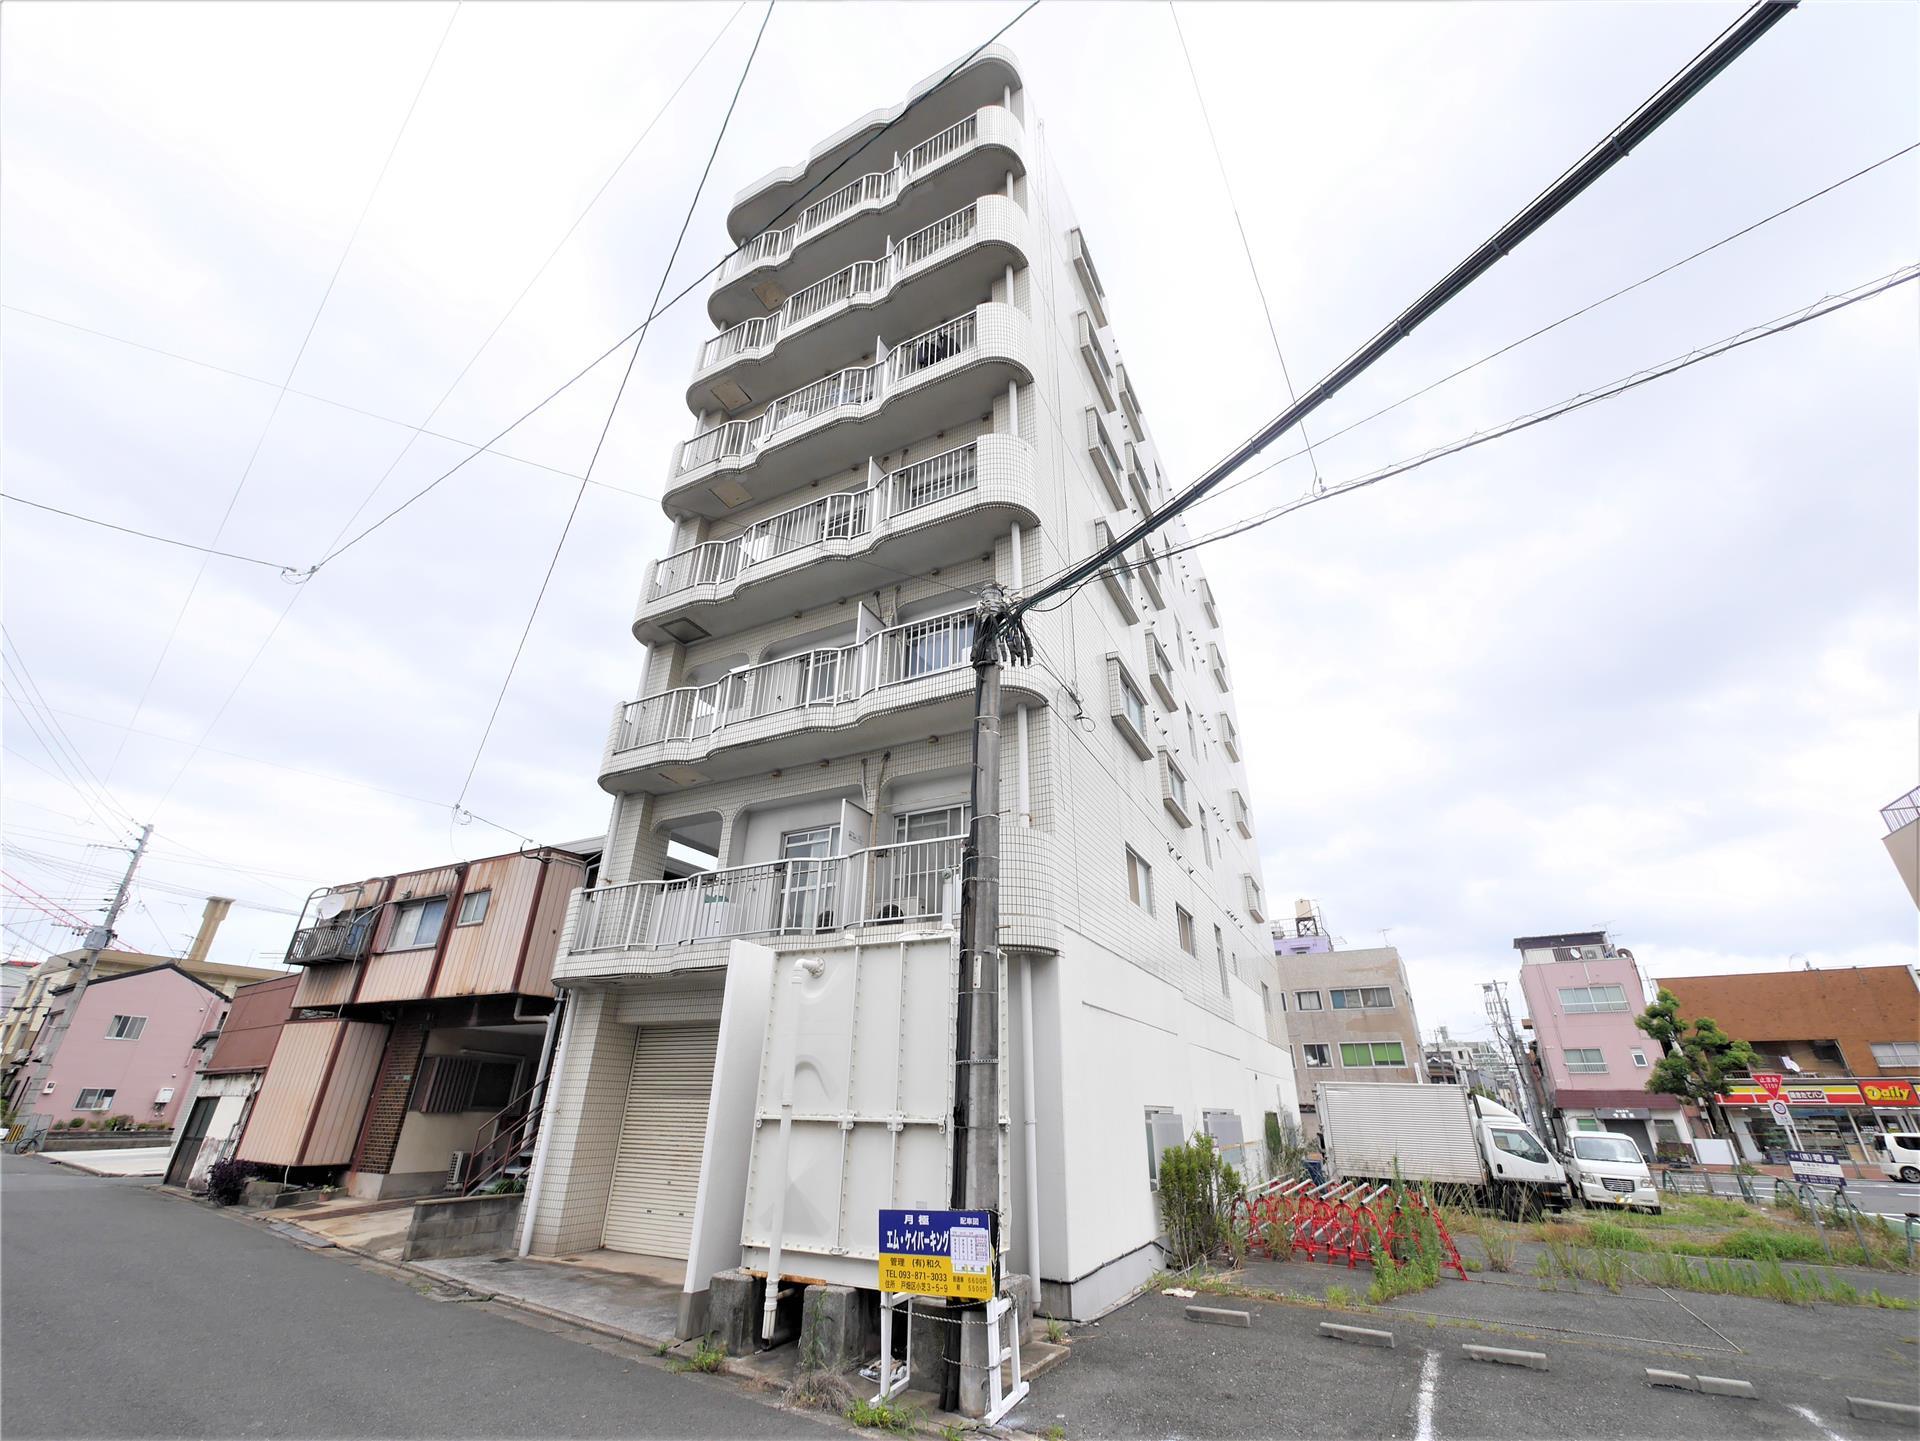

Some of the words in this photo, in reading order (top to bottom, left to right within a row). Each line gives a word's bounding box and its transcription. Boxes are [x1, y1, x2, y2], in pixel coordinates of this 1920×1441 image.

[1864, 1085, 1910, 1100] Daily
[890, 1257, 905, 1266] 管理
[886, 1269, 898, 1279] TEL
[898, 1270, 948, 1282] 093-871-3033
[885, 1280, 896, 1289] 住所
